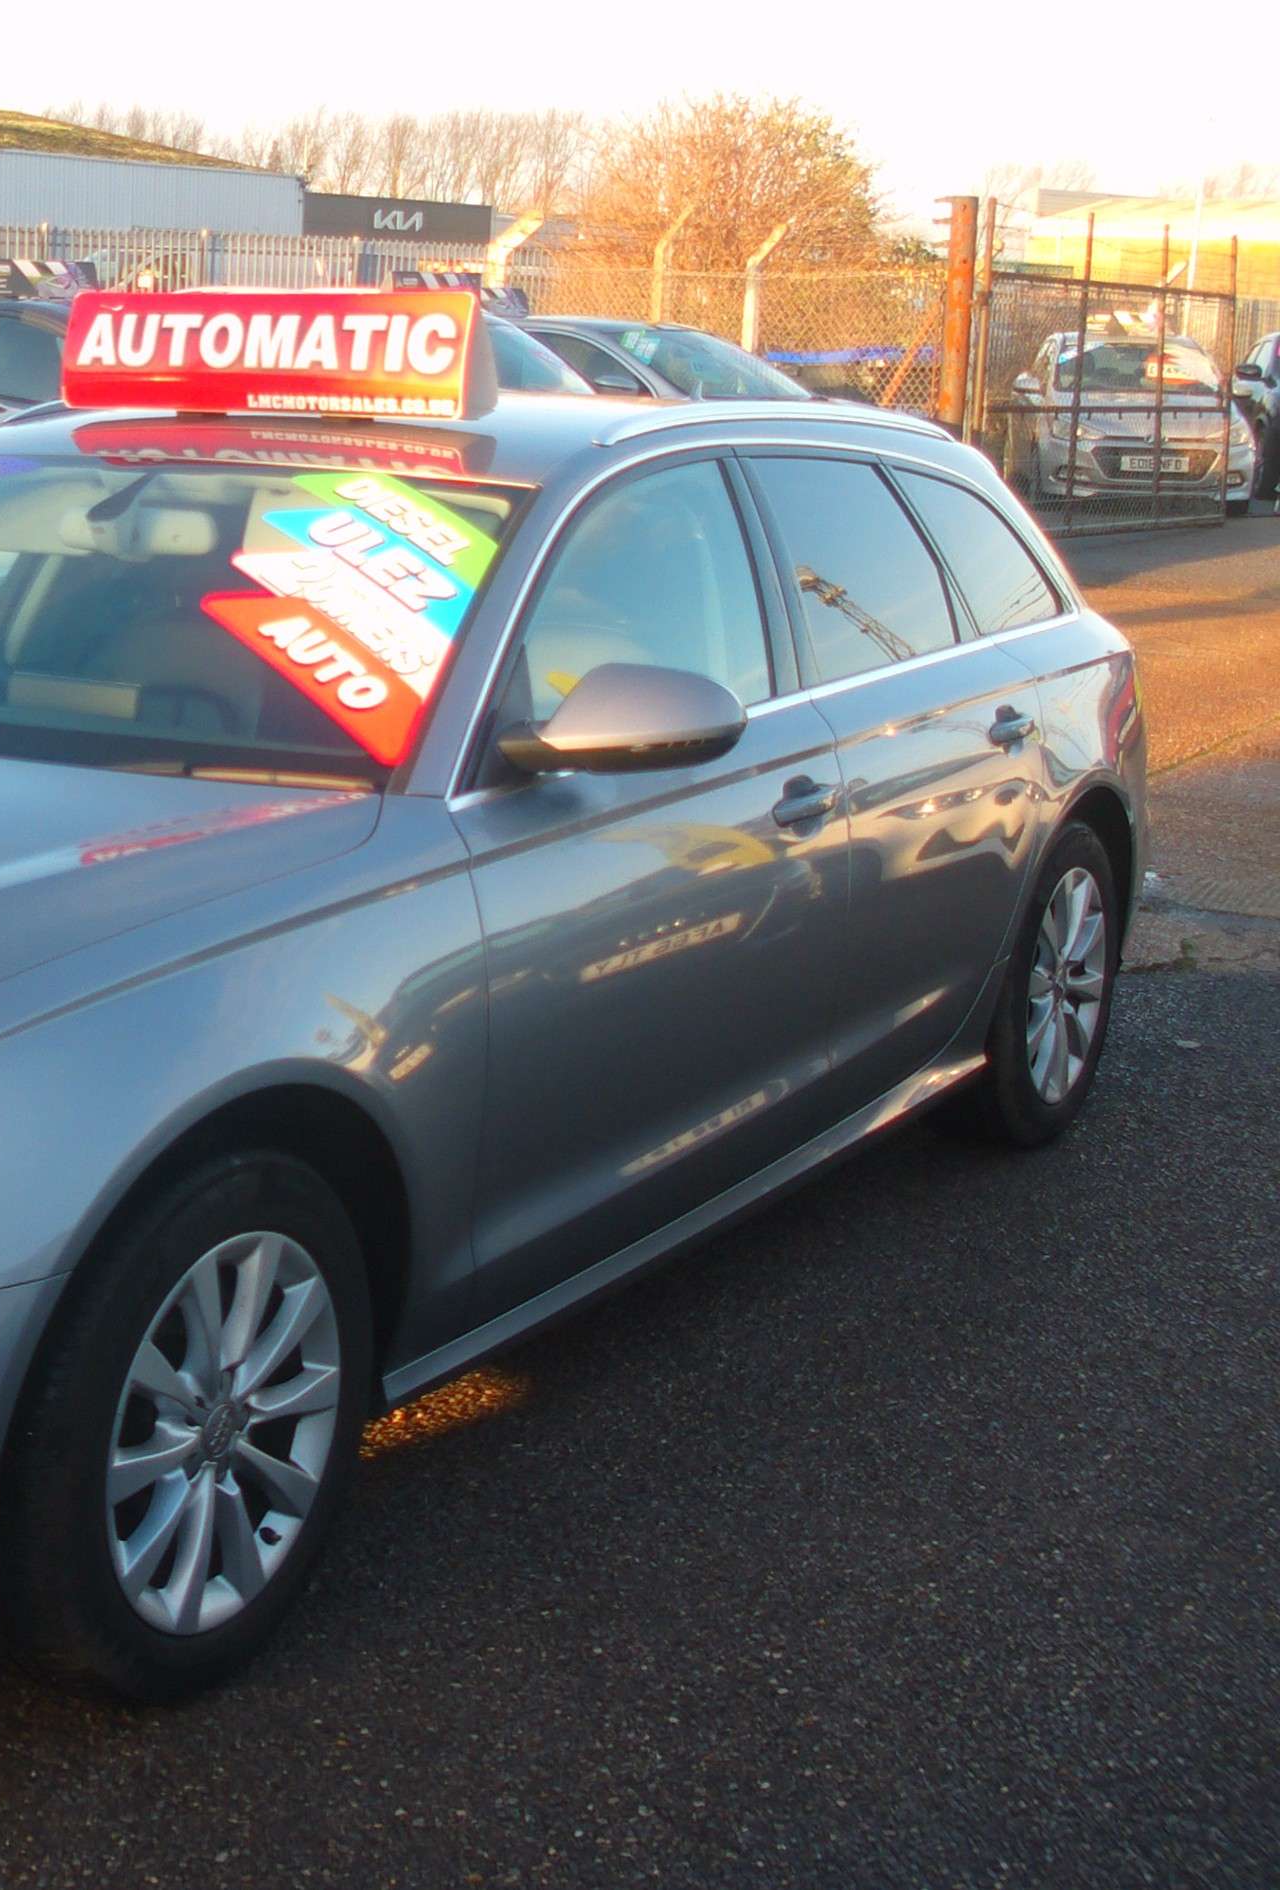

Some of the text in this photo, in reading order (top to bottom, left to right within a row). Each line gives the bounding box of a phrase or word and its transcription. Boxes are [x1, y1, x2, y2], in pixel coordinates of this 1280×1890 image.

[373, 208, 424, 232] KIA
[75, 311, 459, 377] AUTOMATIC
[246, 393, 458, 417] LMCMOTORSALES.CO.UK
[308, 510, 458, 613] ULEZ
[332, 476, 471, 568] DIESEL
[257, 615, 390, 710] AUTO
